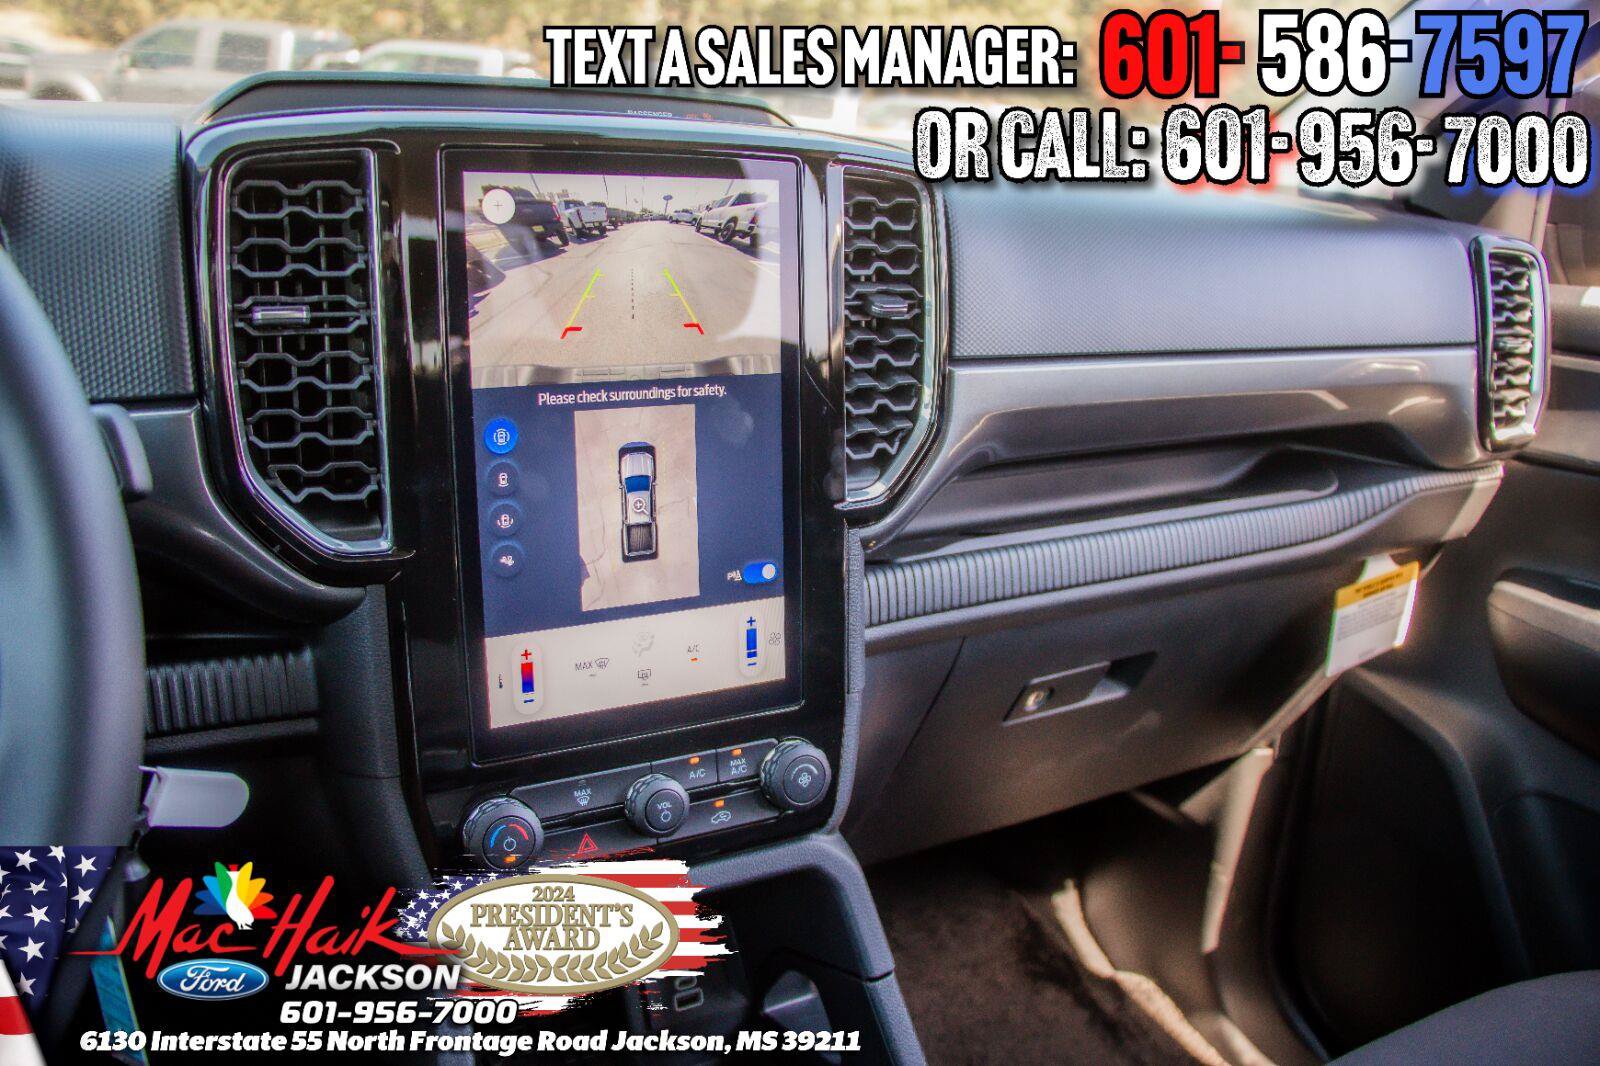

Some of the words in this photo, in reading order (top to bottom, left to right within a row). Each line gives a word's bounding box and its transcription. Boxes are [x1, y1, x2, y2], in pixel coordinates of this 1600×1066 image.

[538, 392, 576, 406] Please
[577, 388, 609, 404] check
[608, 385, 676, 403] surroundings
[677, 385, 693, 398] for
[693, 383, 727, 398] safety.
[575, 661, 593, 672] MAX
[730, 758, 747, 767] MAX
[689, 768, 706, 780] A/C
[731, 765, 748, 776] A/C
[574, 788, 592, 798] MAX
[657, 802, 672, 810] VOL
